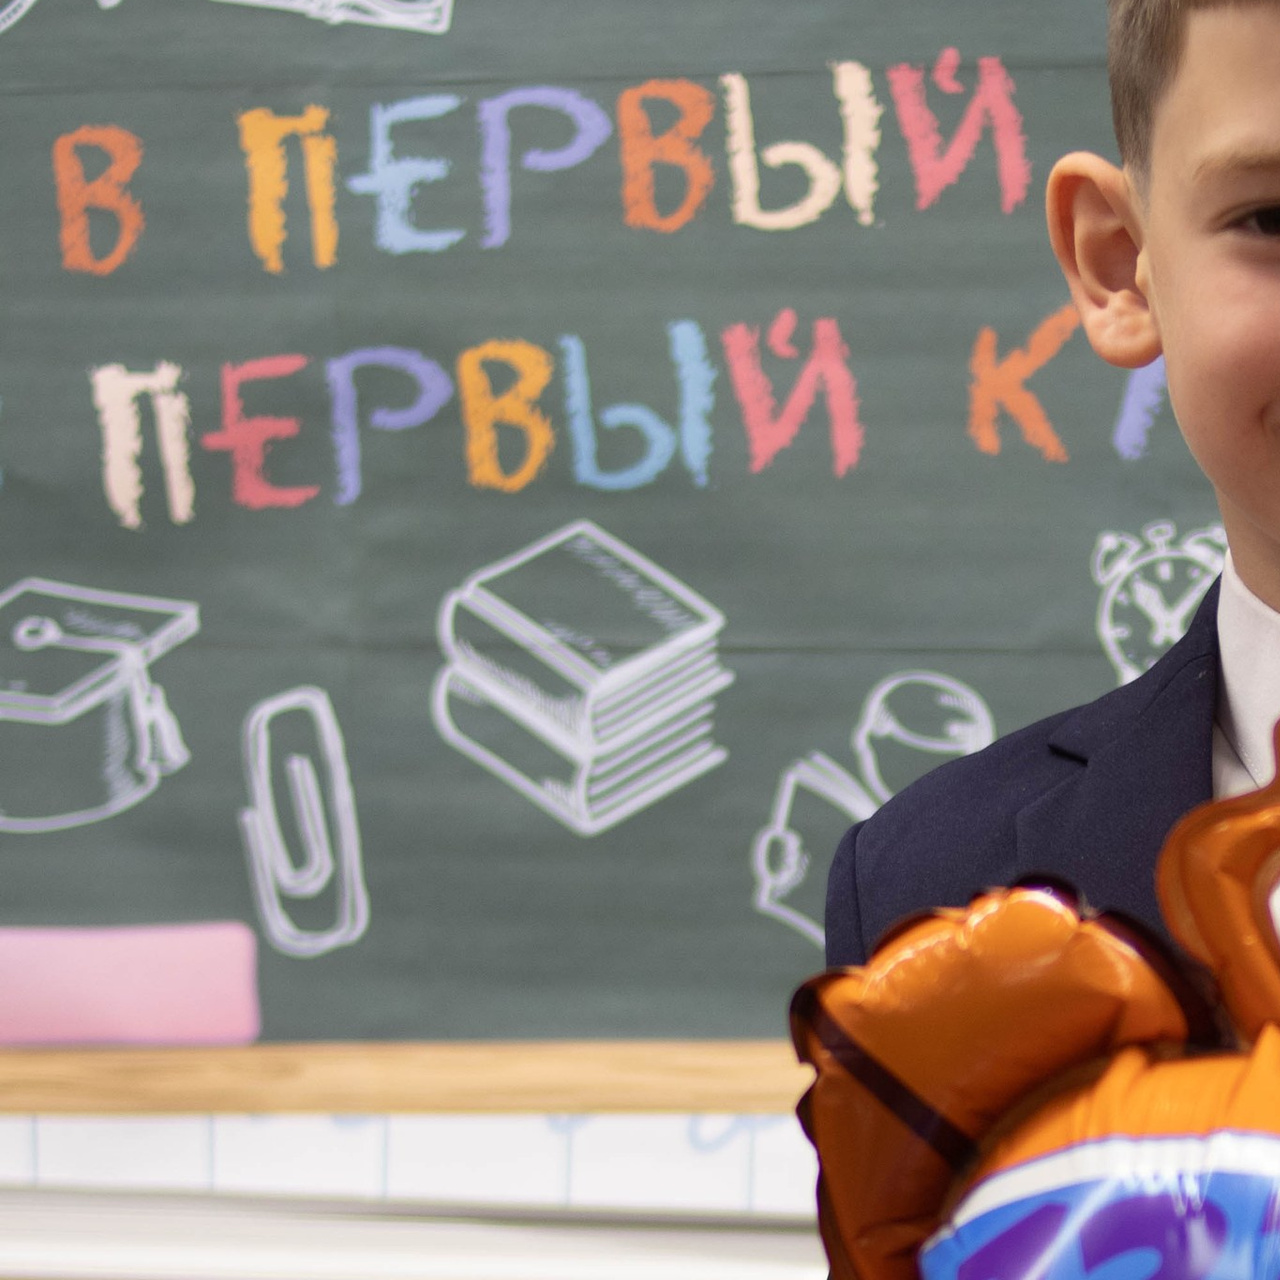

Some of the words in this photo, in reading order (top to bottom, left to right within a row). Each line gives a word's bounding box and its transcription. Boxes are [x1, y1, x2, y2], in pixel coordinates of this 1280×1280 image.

[53, 125, 145, 275] В
[237, 47, 1033, 273] ПЕРВЫЙ
[91, 307, 865, 529] ПЕРВЫЙ
